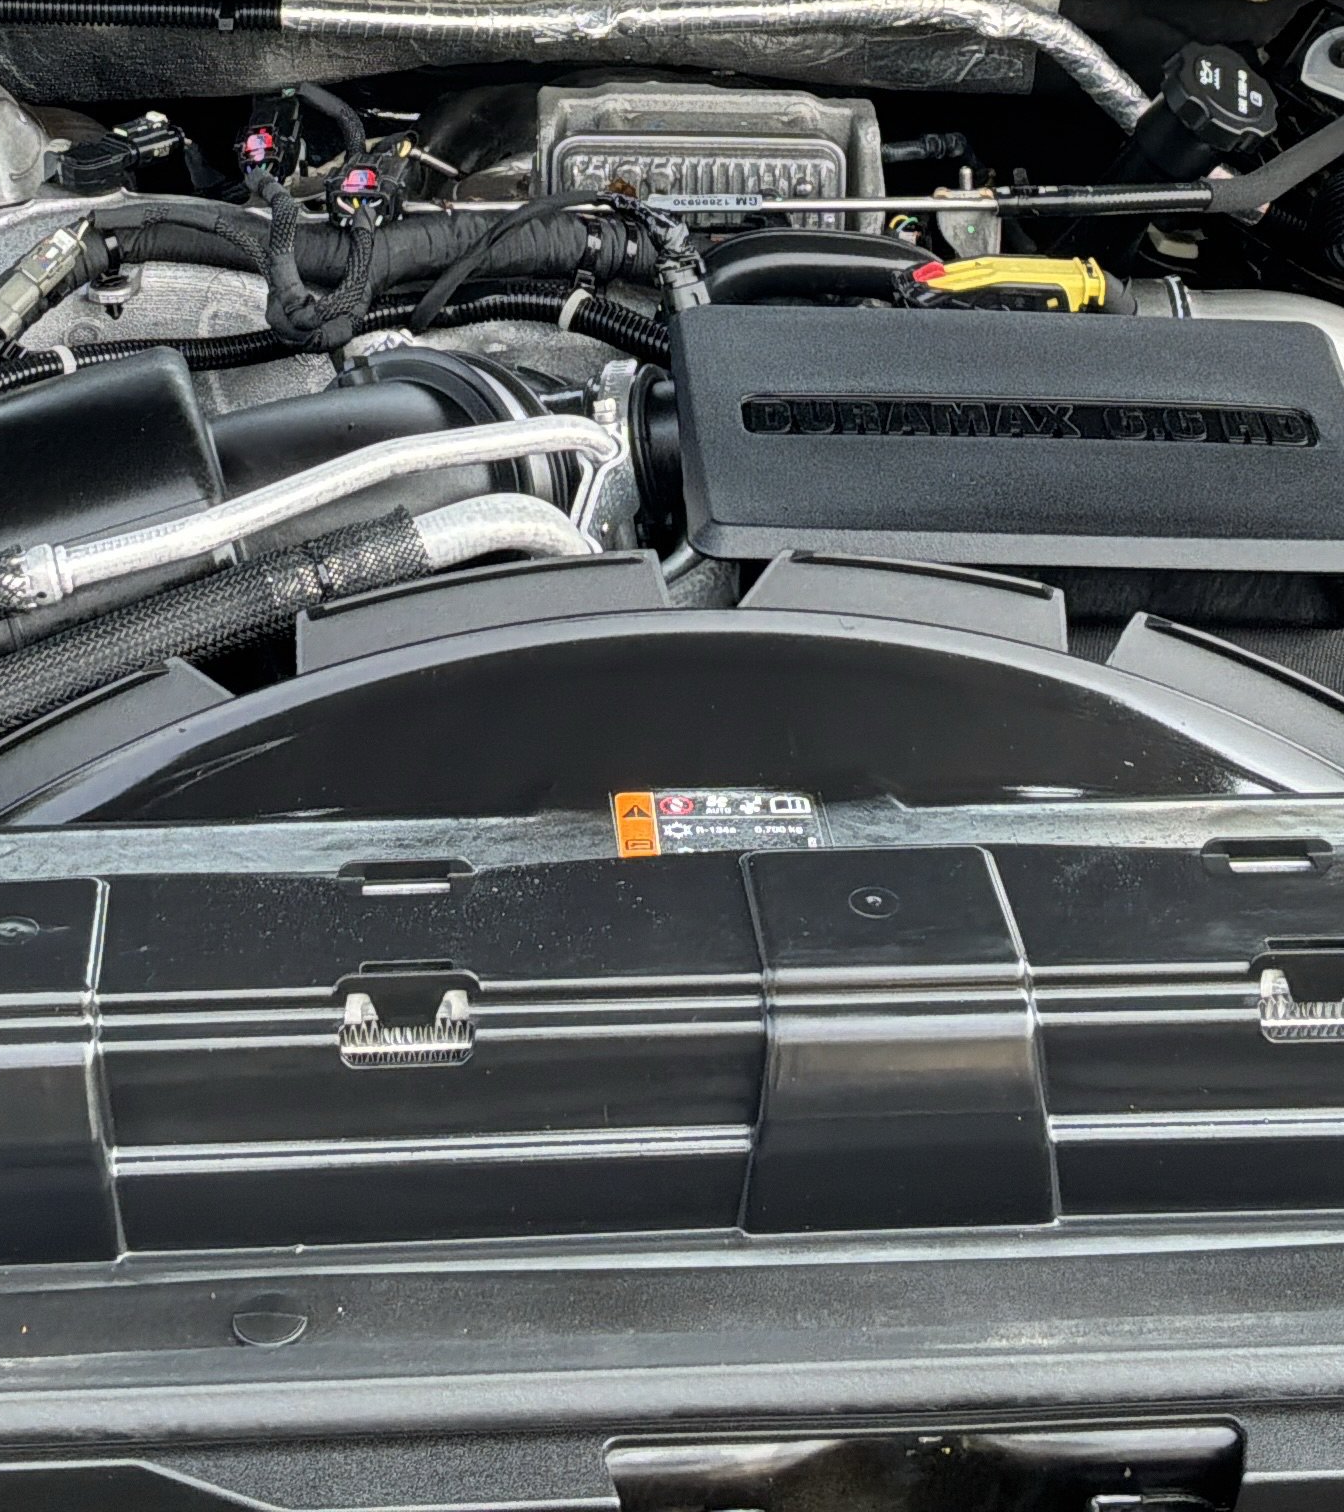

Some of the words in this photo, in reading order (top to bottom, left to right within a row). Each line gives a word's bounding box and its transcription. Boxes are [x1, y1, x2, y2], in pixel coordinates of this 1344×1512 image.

[735, 196, 758, 206] GM
[747, 399, 1081, 438] DURAMAX
[1219, 408, 1309, 447] HD
